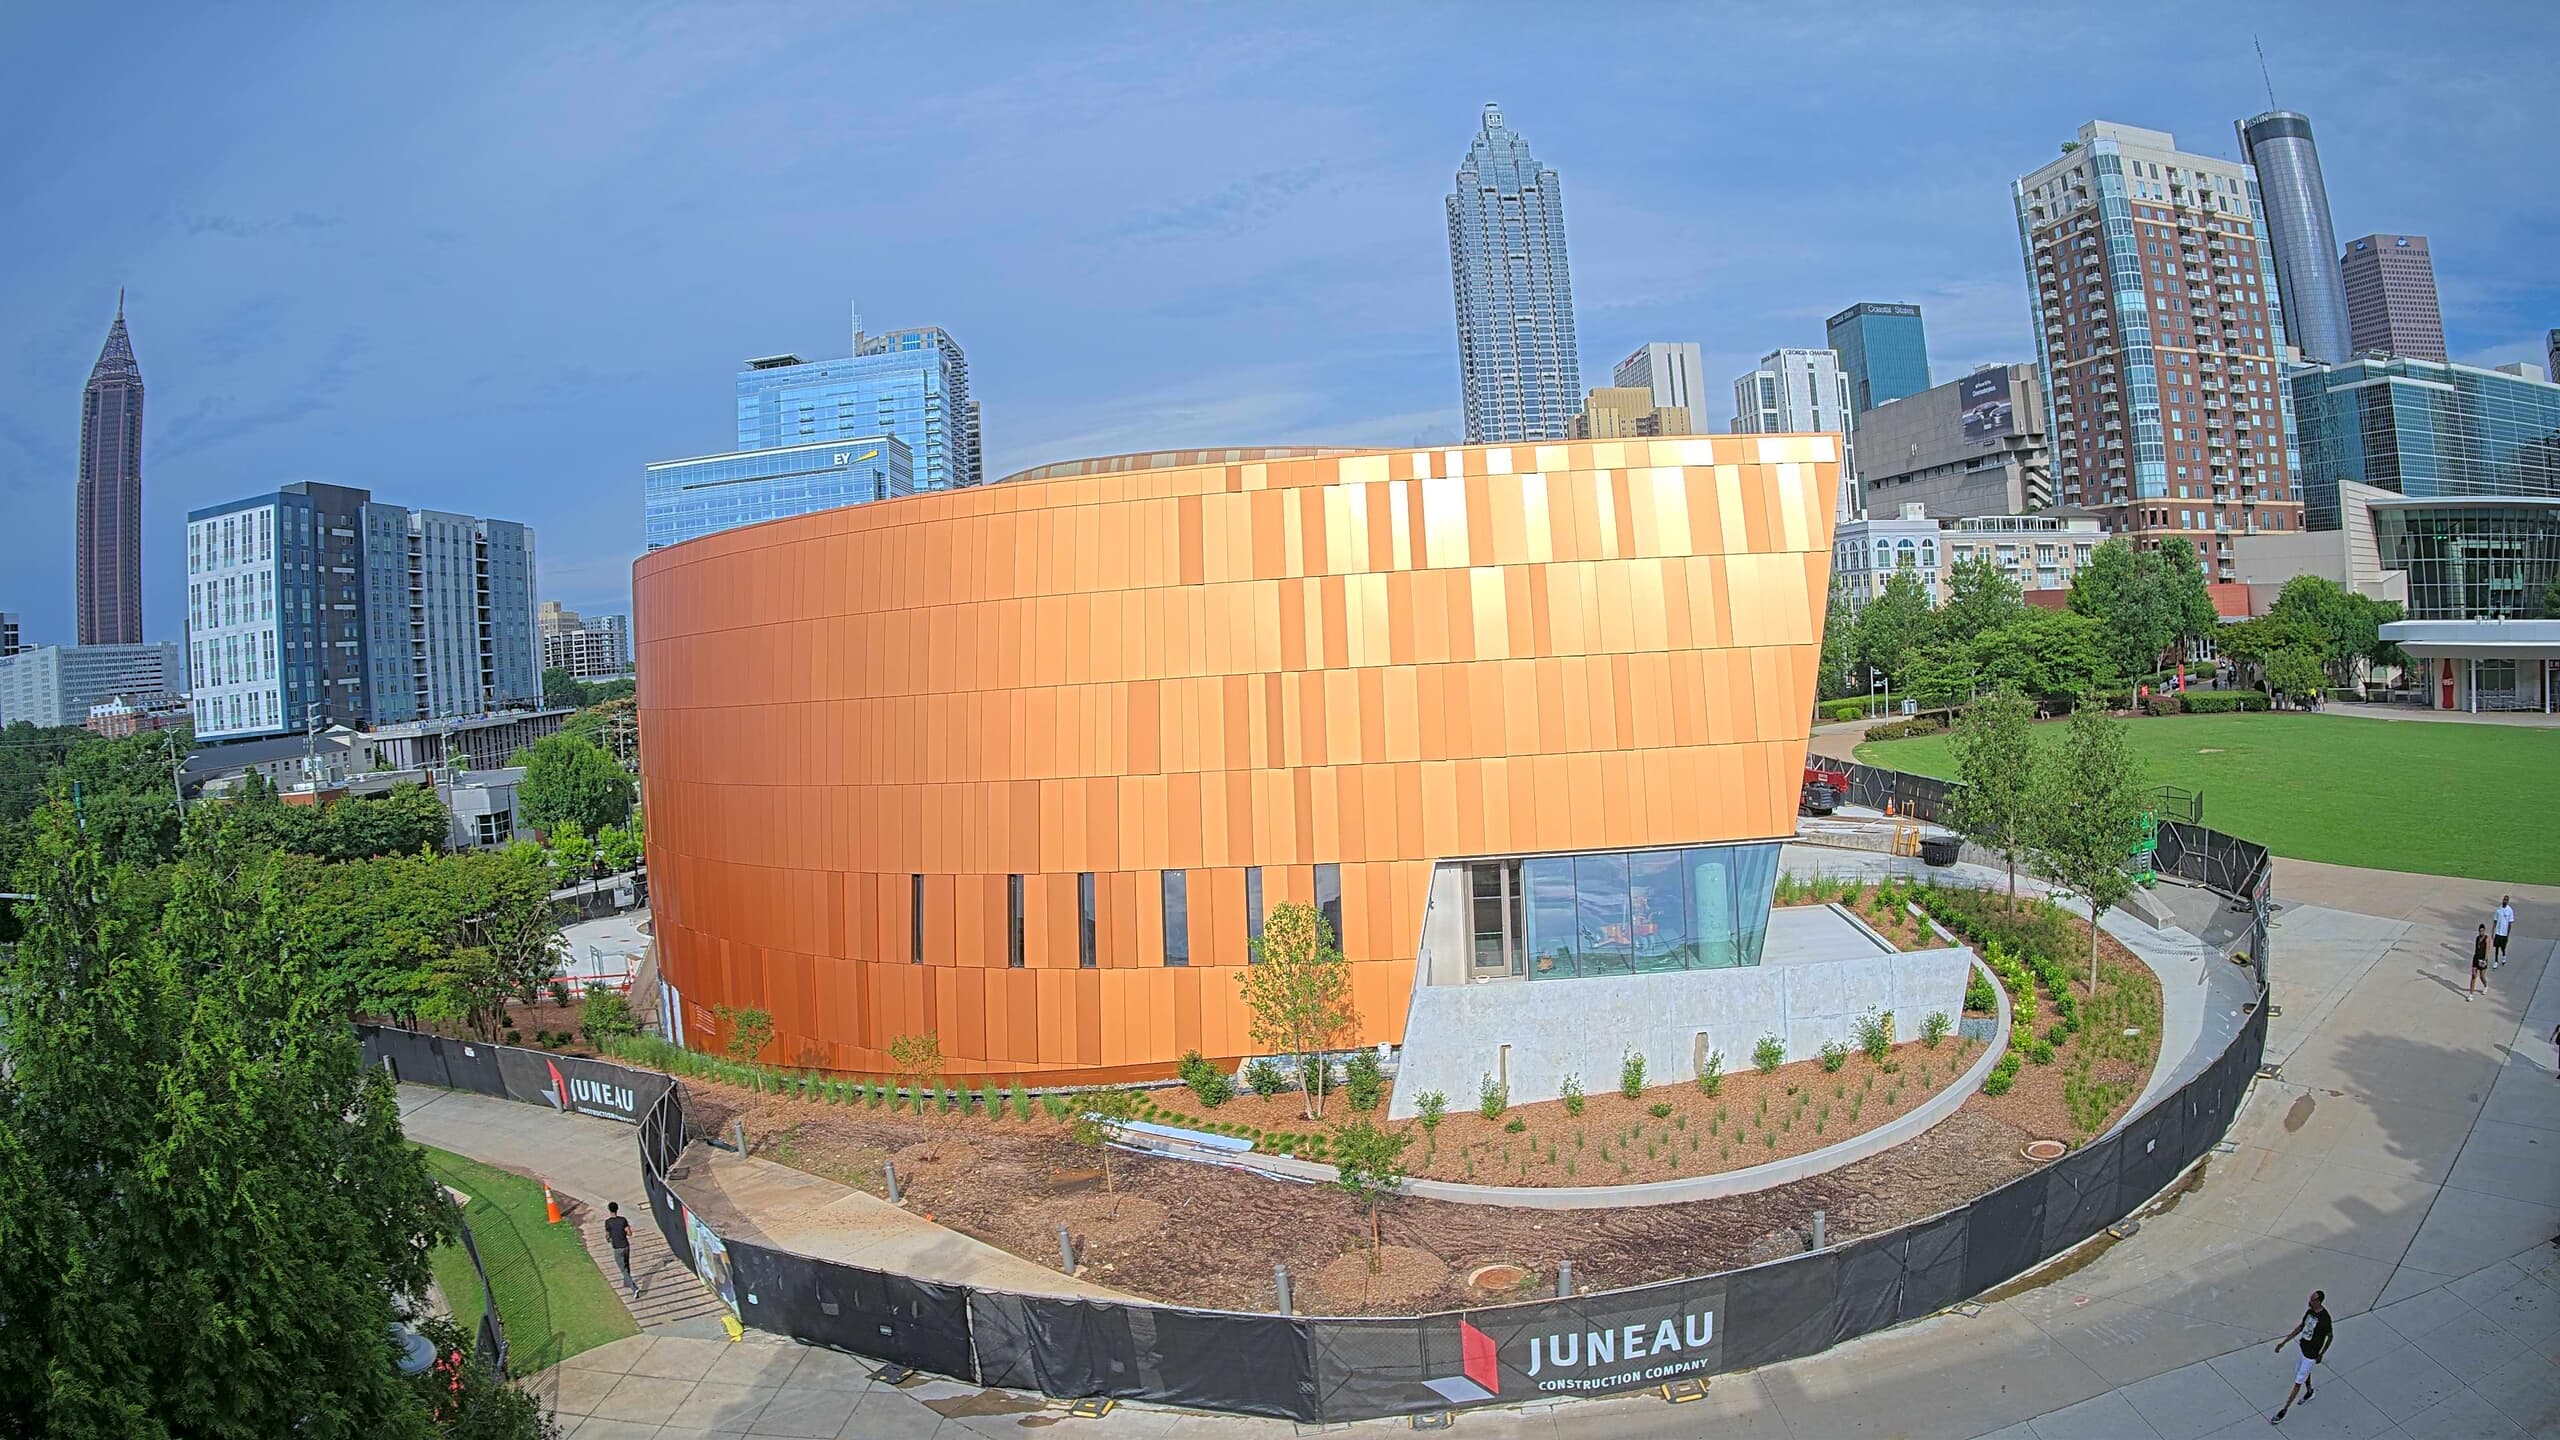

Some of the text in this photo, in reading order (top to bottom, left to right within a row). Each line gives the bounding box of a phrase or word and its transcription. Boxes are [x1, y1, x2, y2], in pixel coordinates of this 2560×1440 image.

[1867, 304, 1915, 315] Coastal States
[833, 452, 851, 465] EY
[570, 1078, 634, 1112] JUNEAU
[1527, 1311, 1714, 1377] JUNEAU
[1538, 1358, 1709, 1391] CONSTRUCTION COMPANY
